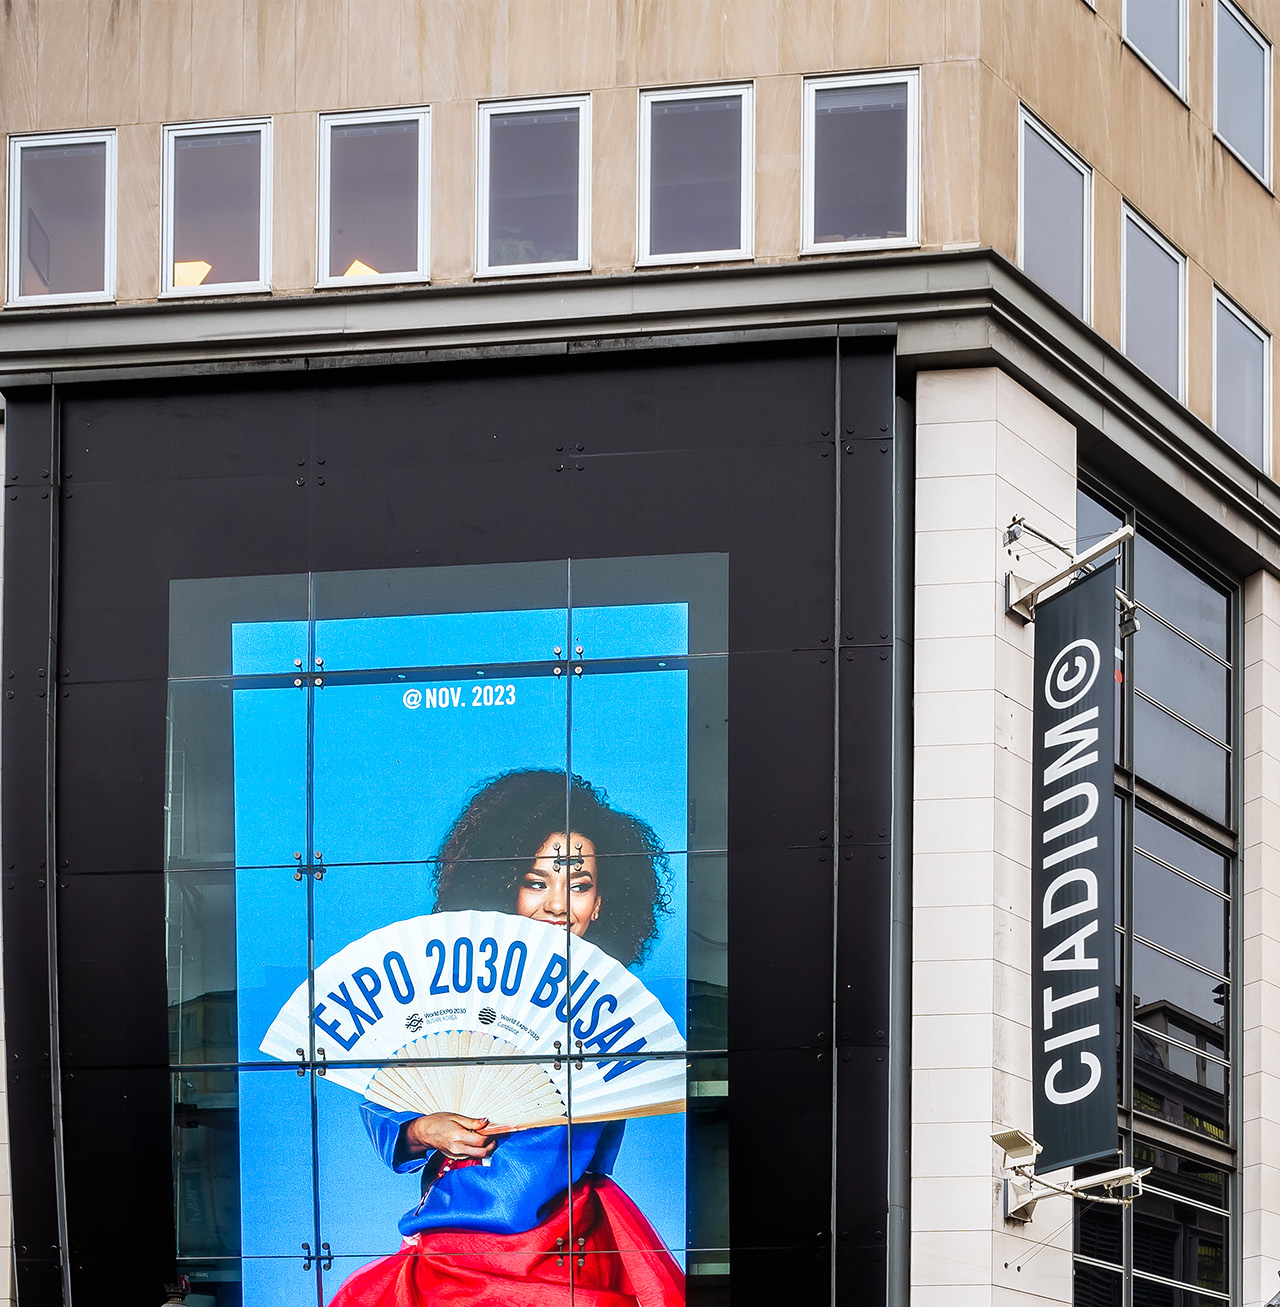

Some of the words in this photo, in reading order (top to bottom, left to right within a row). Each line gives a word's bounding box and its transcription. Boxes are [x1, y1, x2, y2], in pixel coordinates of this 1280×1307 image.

[471, 684, 517, 708] 2023
[313, 950, 415, 1052] EXPO
[425, 936, 528, 997] 2030
[530, 953, 649, 1083] BUSAN
